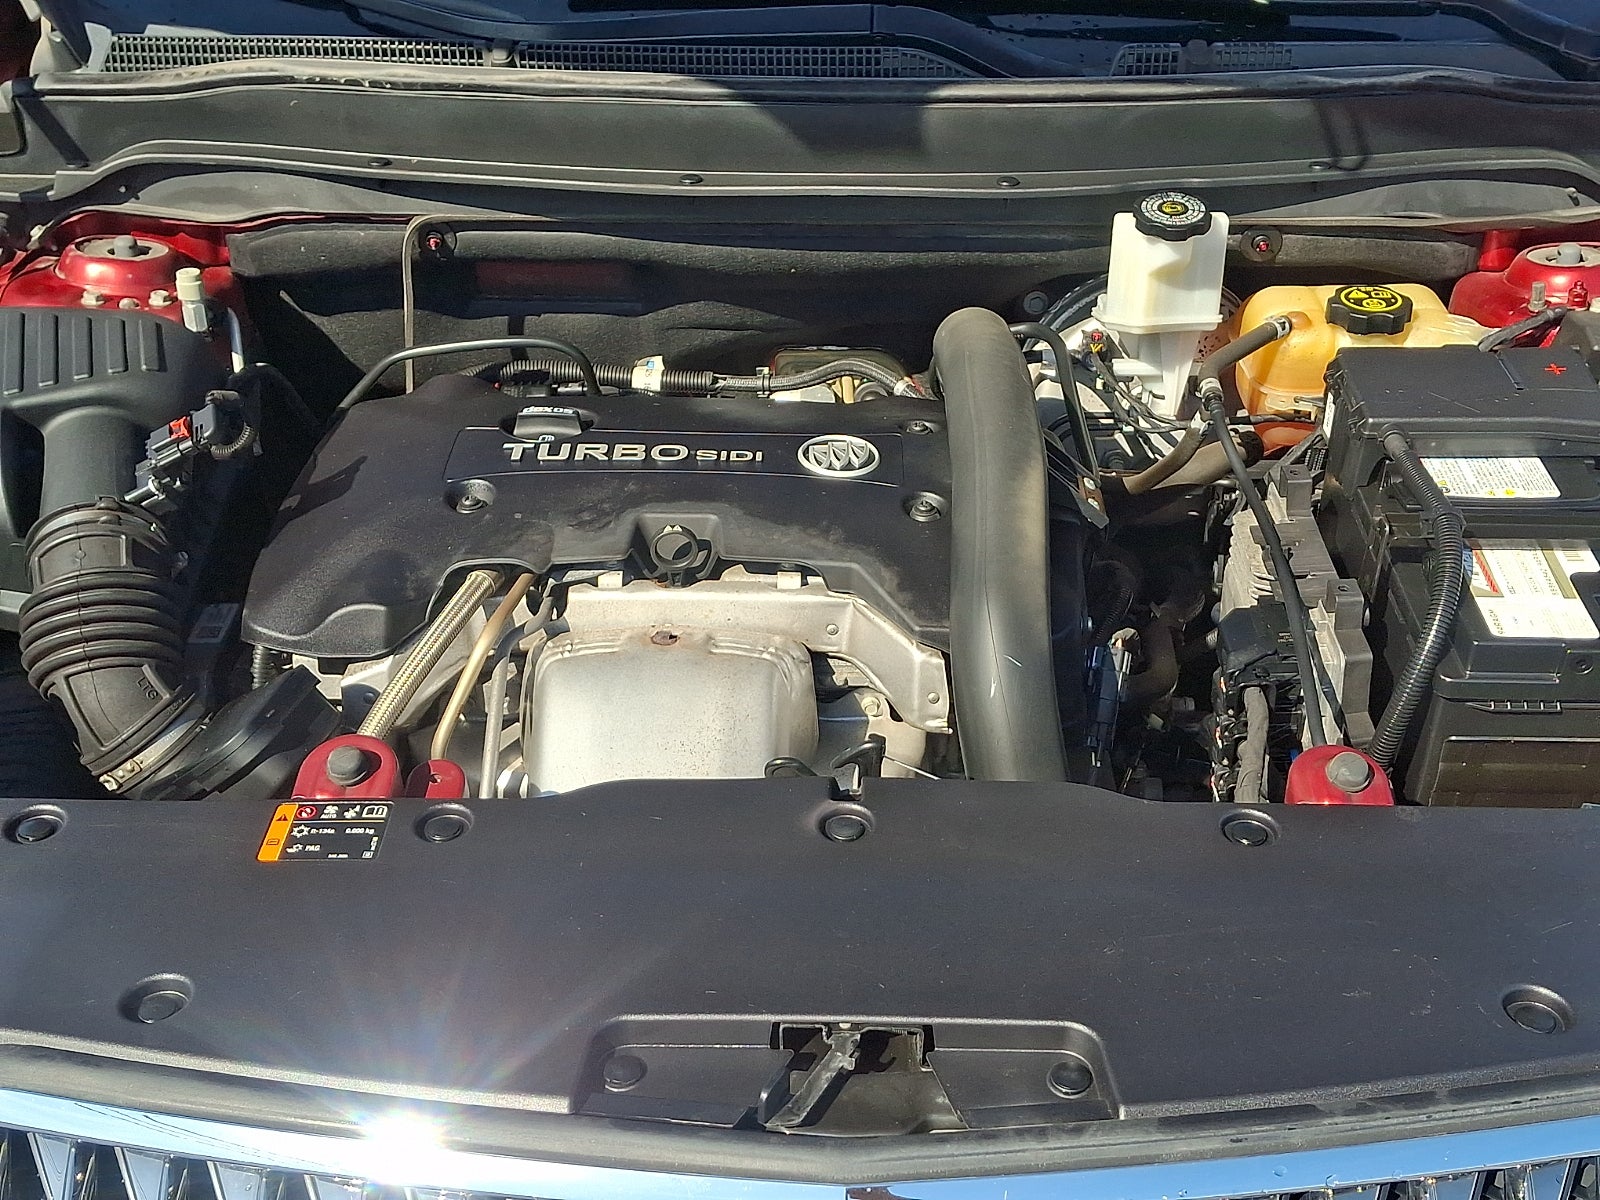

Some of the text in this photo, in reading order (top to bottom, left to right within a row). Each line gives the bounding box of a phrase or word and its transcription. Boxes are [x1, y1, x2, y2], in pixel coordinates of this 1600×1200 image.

[522, 405, 574, 414] dexos
[503, 443, 763, 462] TURBO SIDI
[136, 676, 159, 700] LTG
